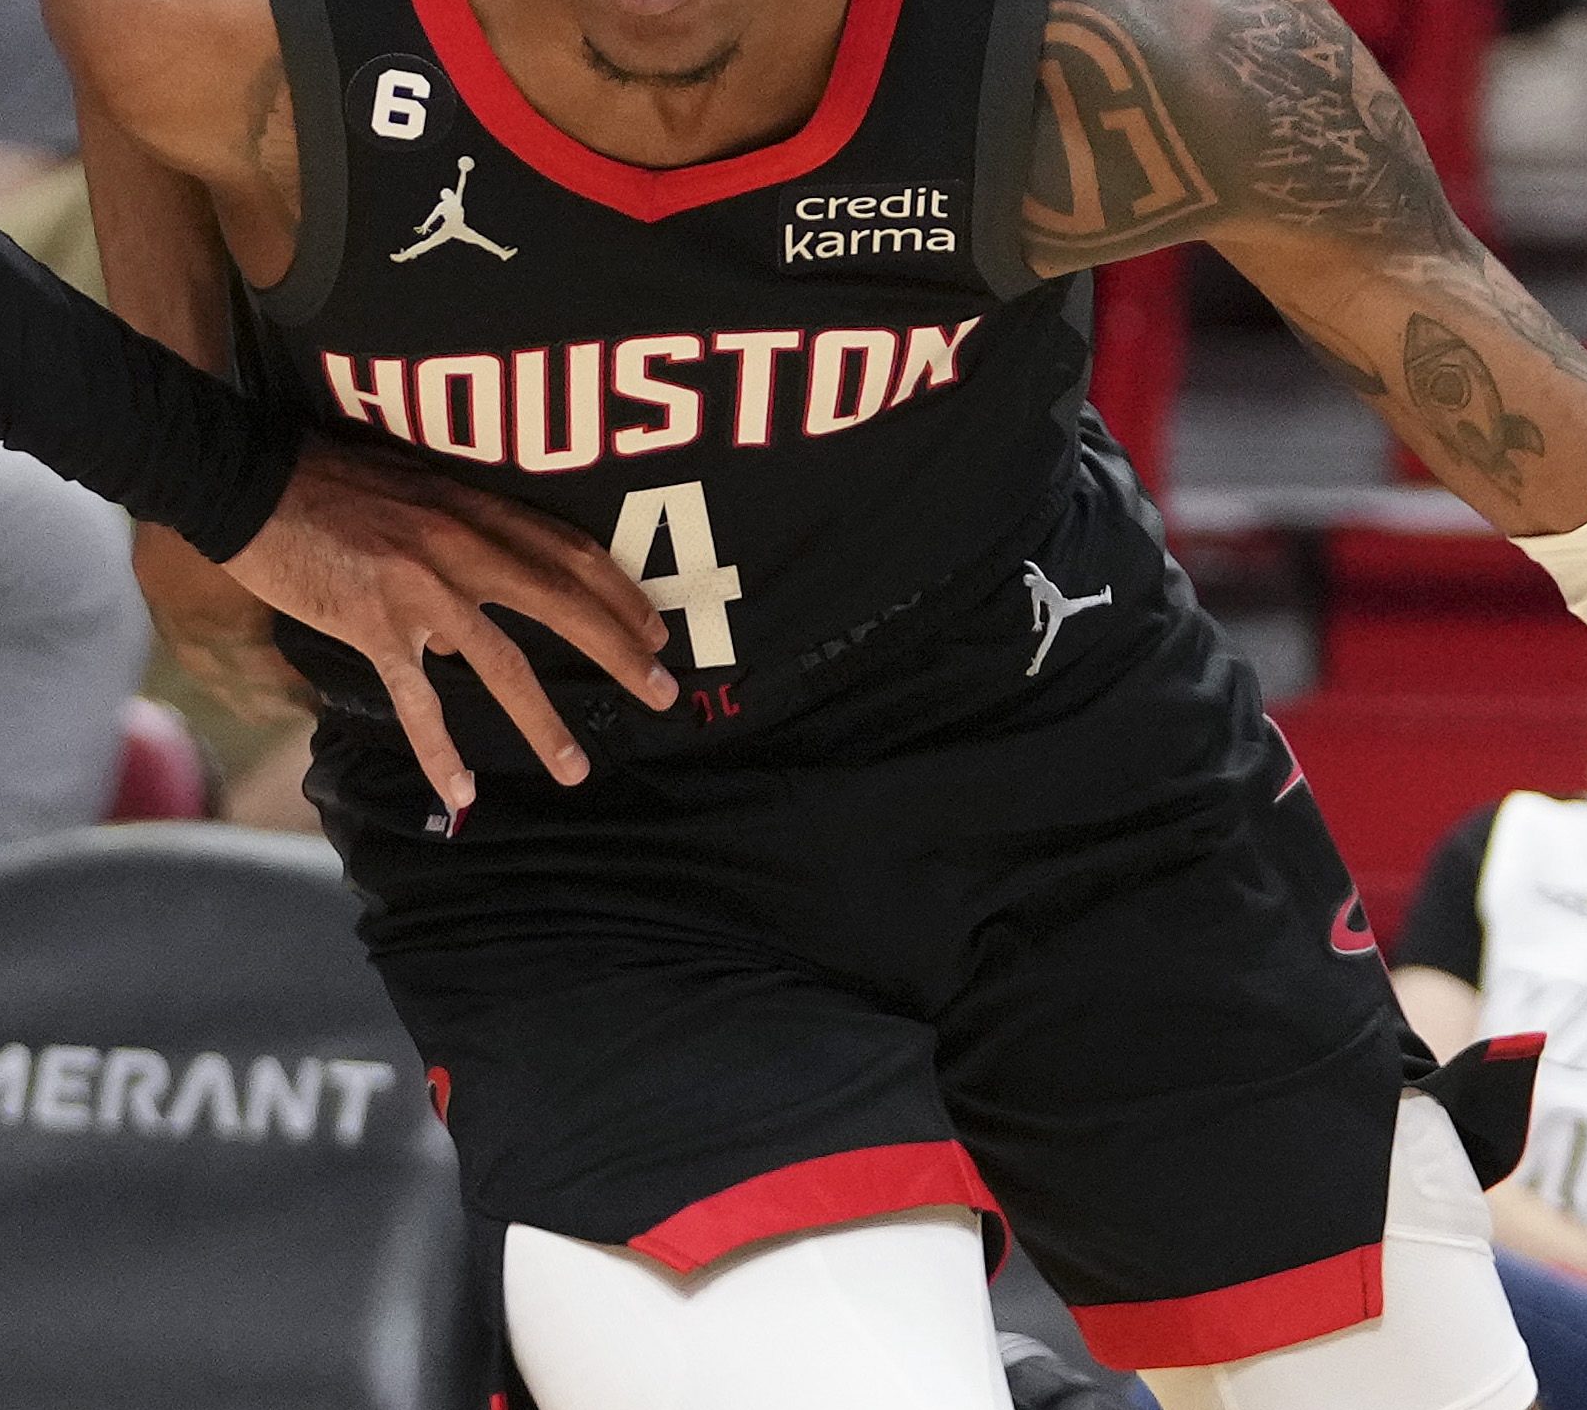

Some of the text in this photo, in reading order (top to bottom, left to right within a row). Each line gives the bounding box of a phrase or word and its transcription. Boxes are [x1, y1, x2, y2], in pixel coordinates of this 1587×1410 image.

[369, 67, 431, 142] 6
[795, 187, 950, 221] credit
[784, 224, 957, 264] karma
[323, 314, 985, 474] HOUSTON
[608, 479, 744, 671] 4
